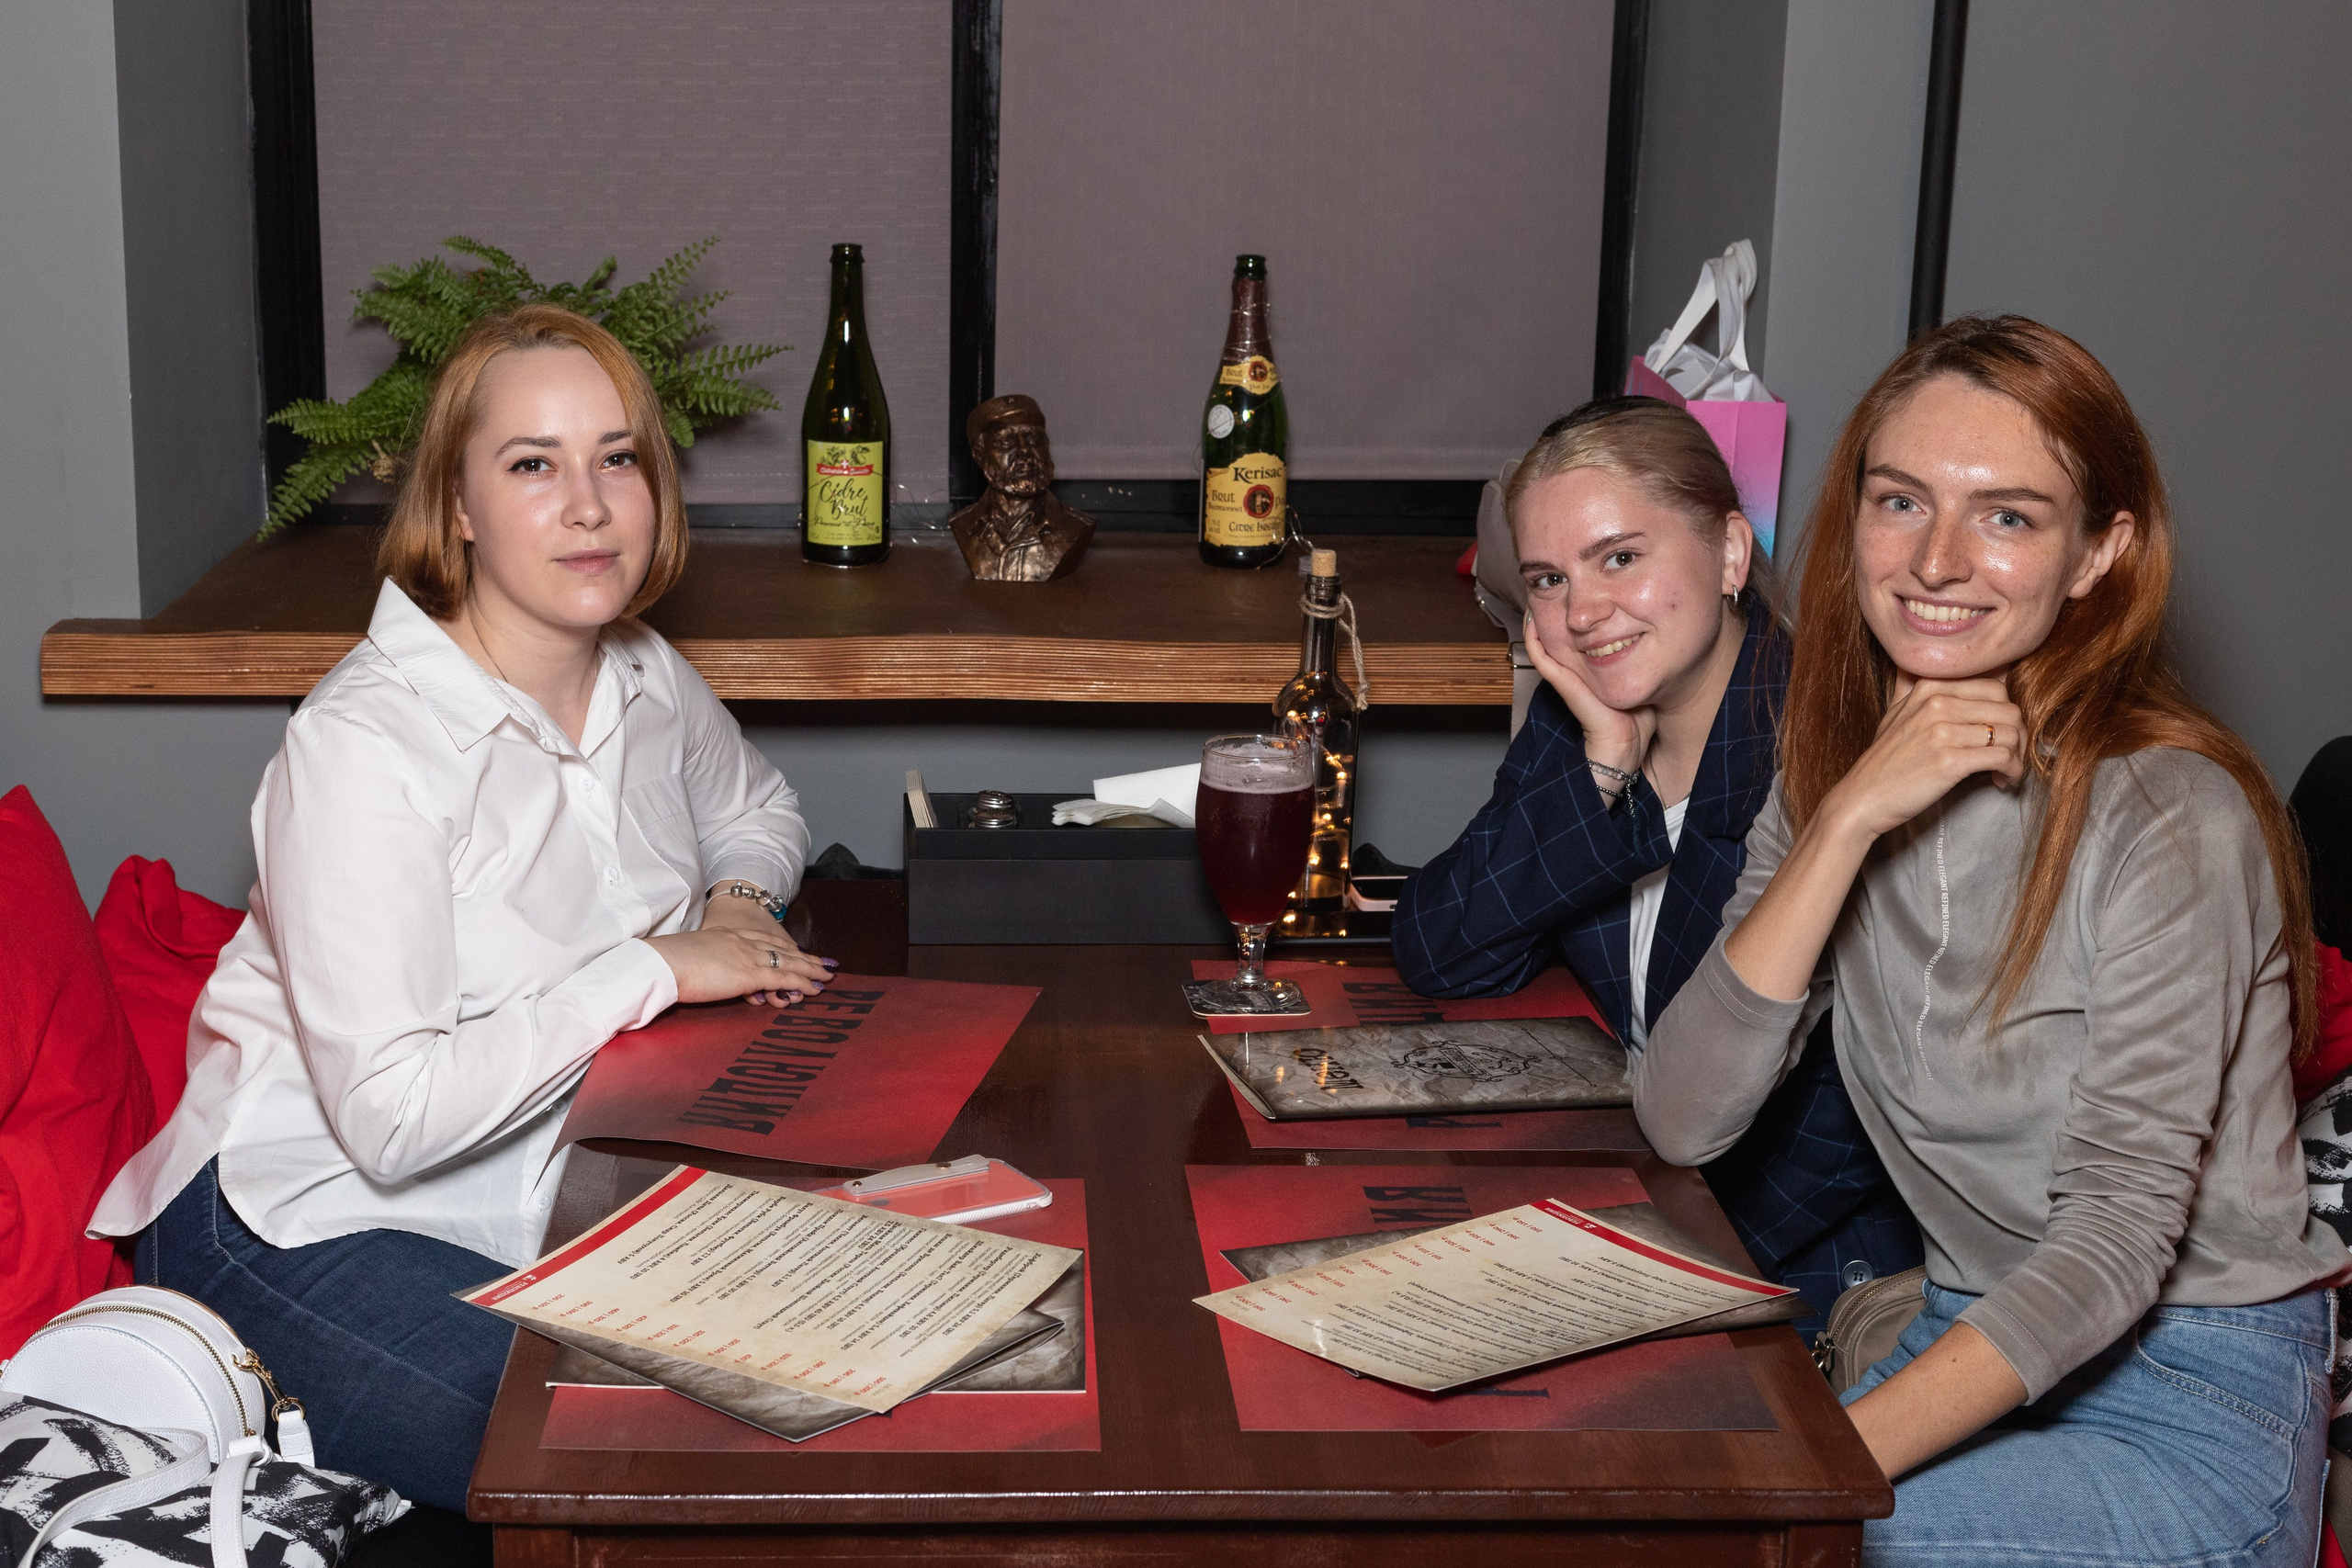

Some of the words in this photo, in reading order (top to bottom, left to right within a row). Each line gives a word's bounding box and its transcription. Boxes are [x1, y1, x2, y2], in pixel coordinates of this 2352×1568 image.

[1233, 467, 1283, 484] Kerisac
[820, 478, 865, 502] Cidre
[830, 494, 868, 520] Brut
[676, 989, 886, 1135] РЕВОЛЮЦИЯ
